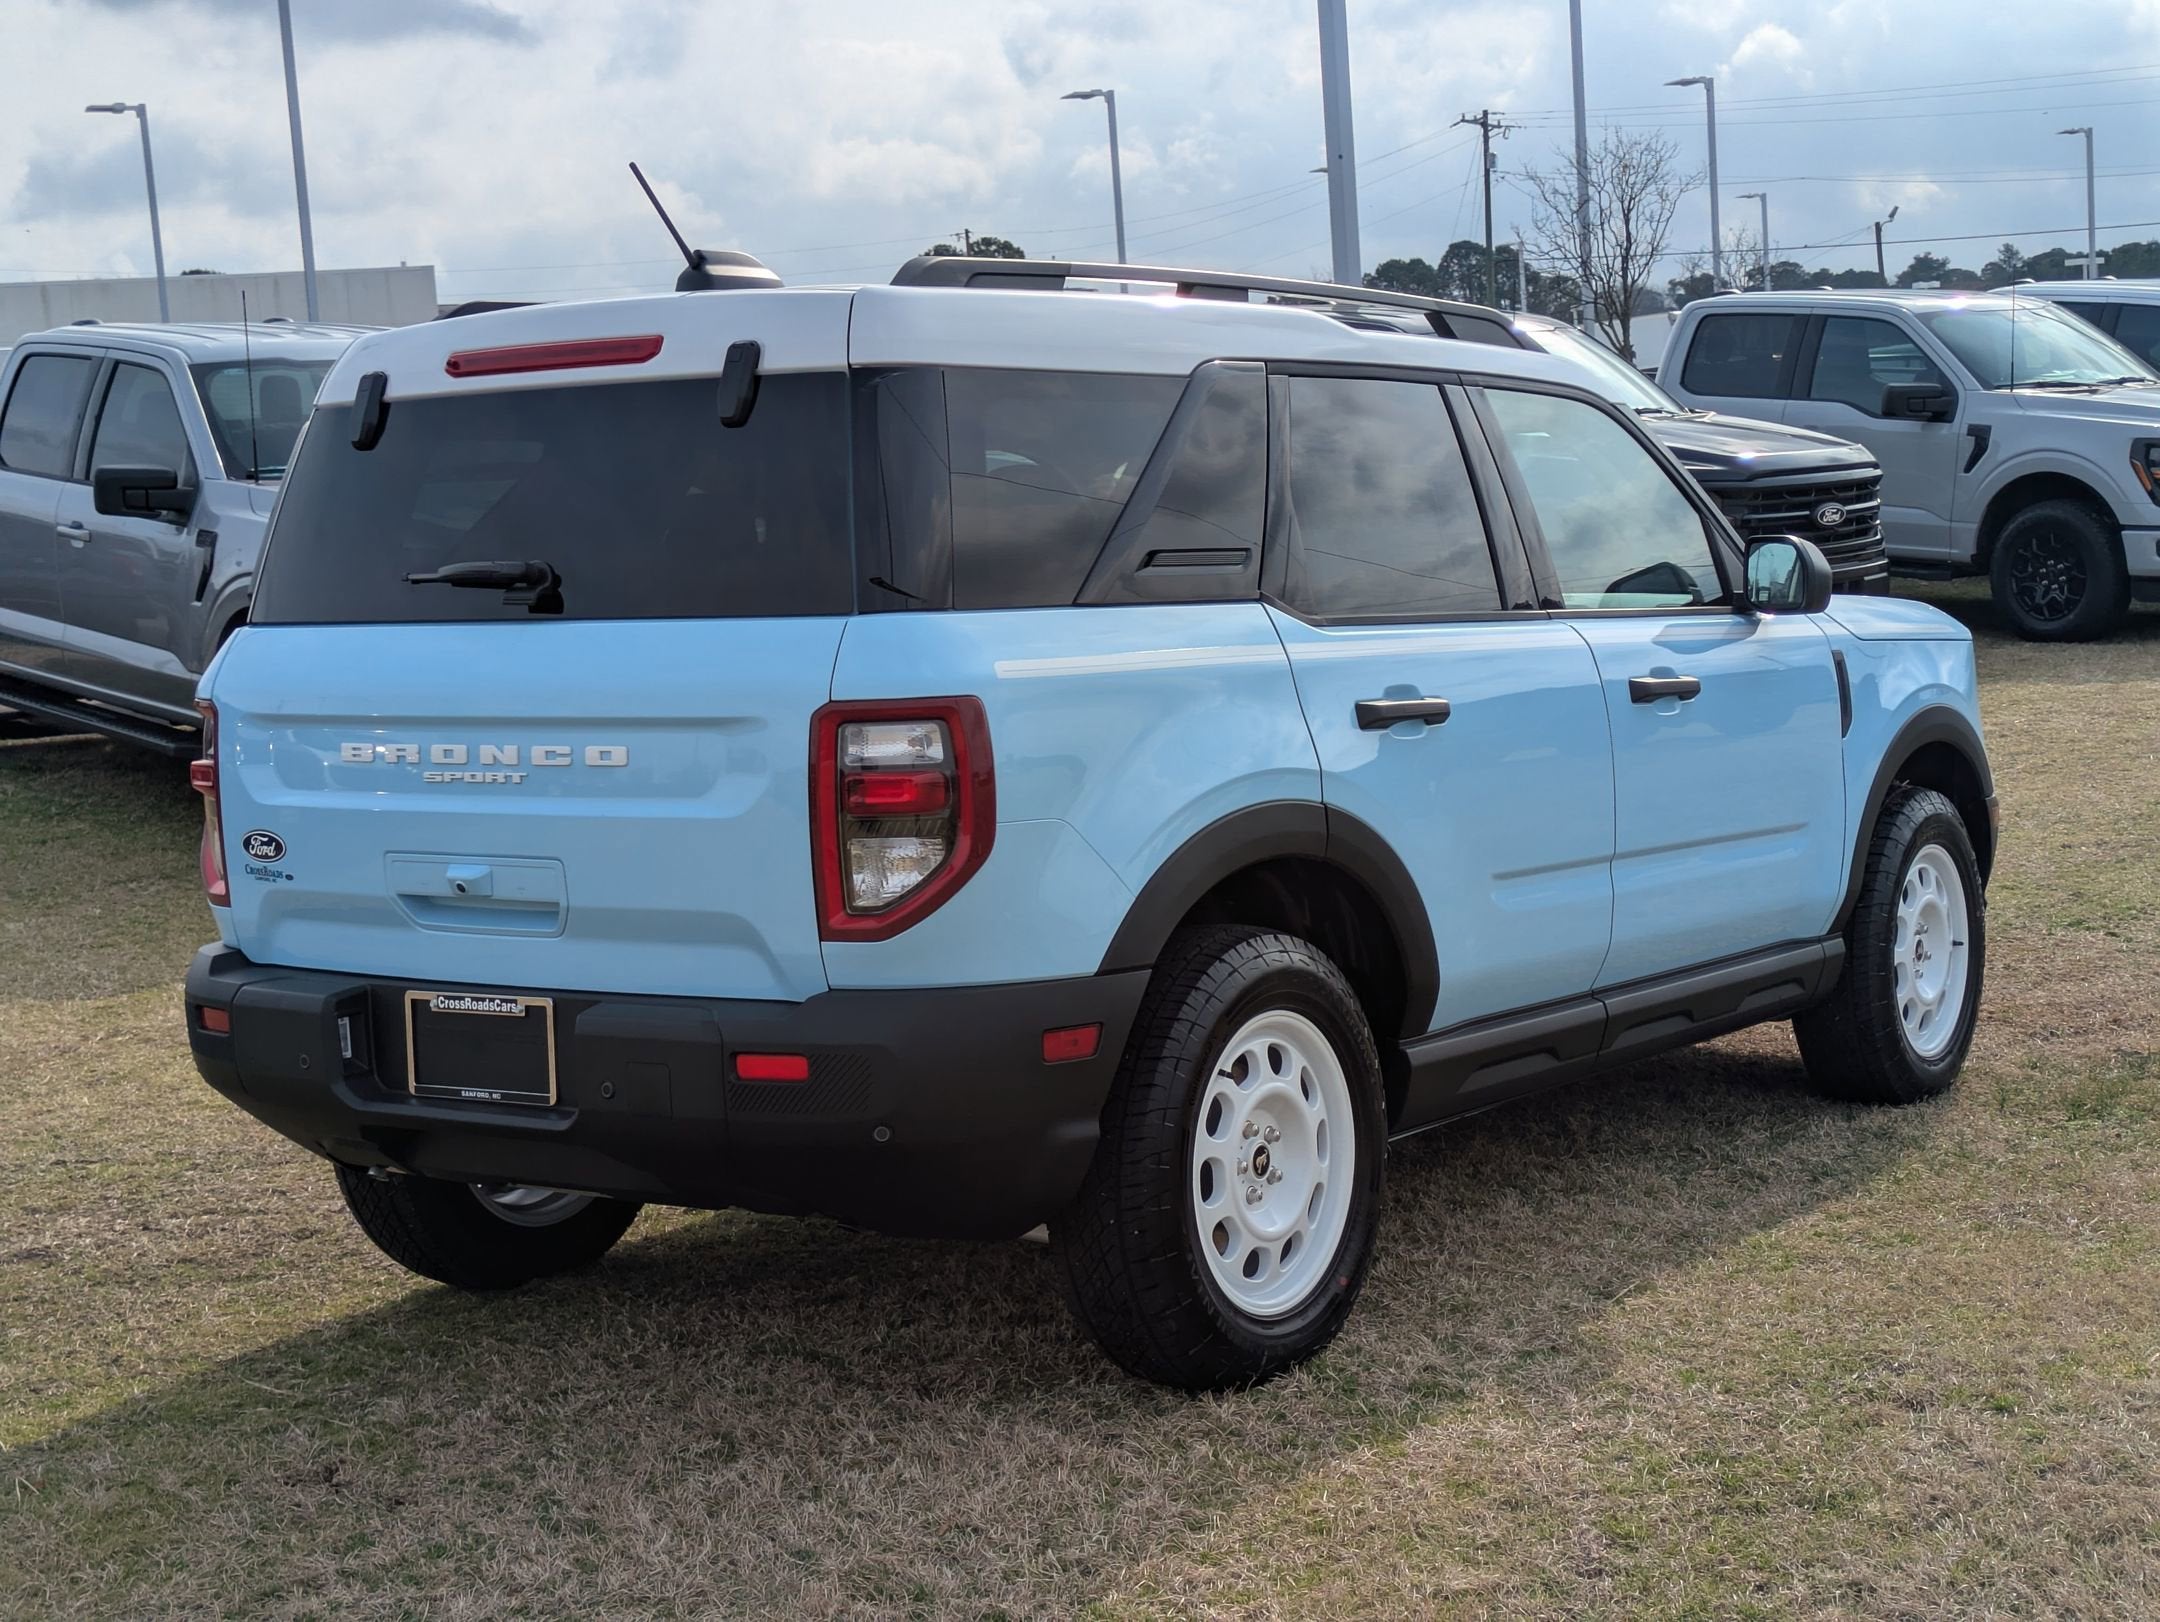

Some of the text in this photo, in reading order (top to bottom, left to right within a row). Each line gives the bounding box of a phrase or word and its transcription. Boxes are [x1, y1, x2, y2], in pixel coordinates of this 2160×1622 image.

[340, 742, 629, 767] BRONCO
[423, 771, 528, 784] SPORT
[249, 835, 276, 857] Ford
[437, 996, 516, 1014] CrossRoadsCars
